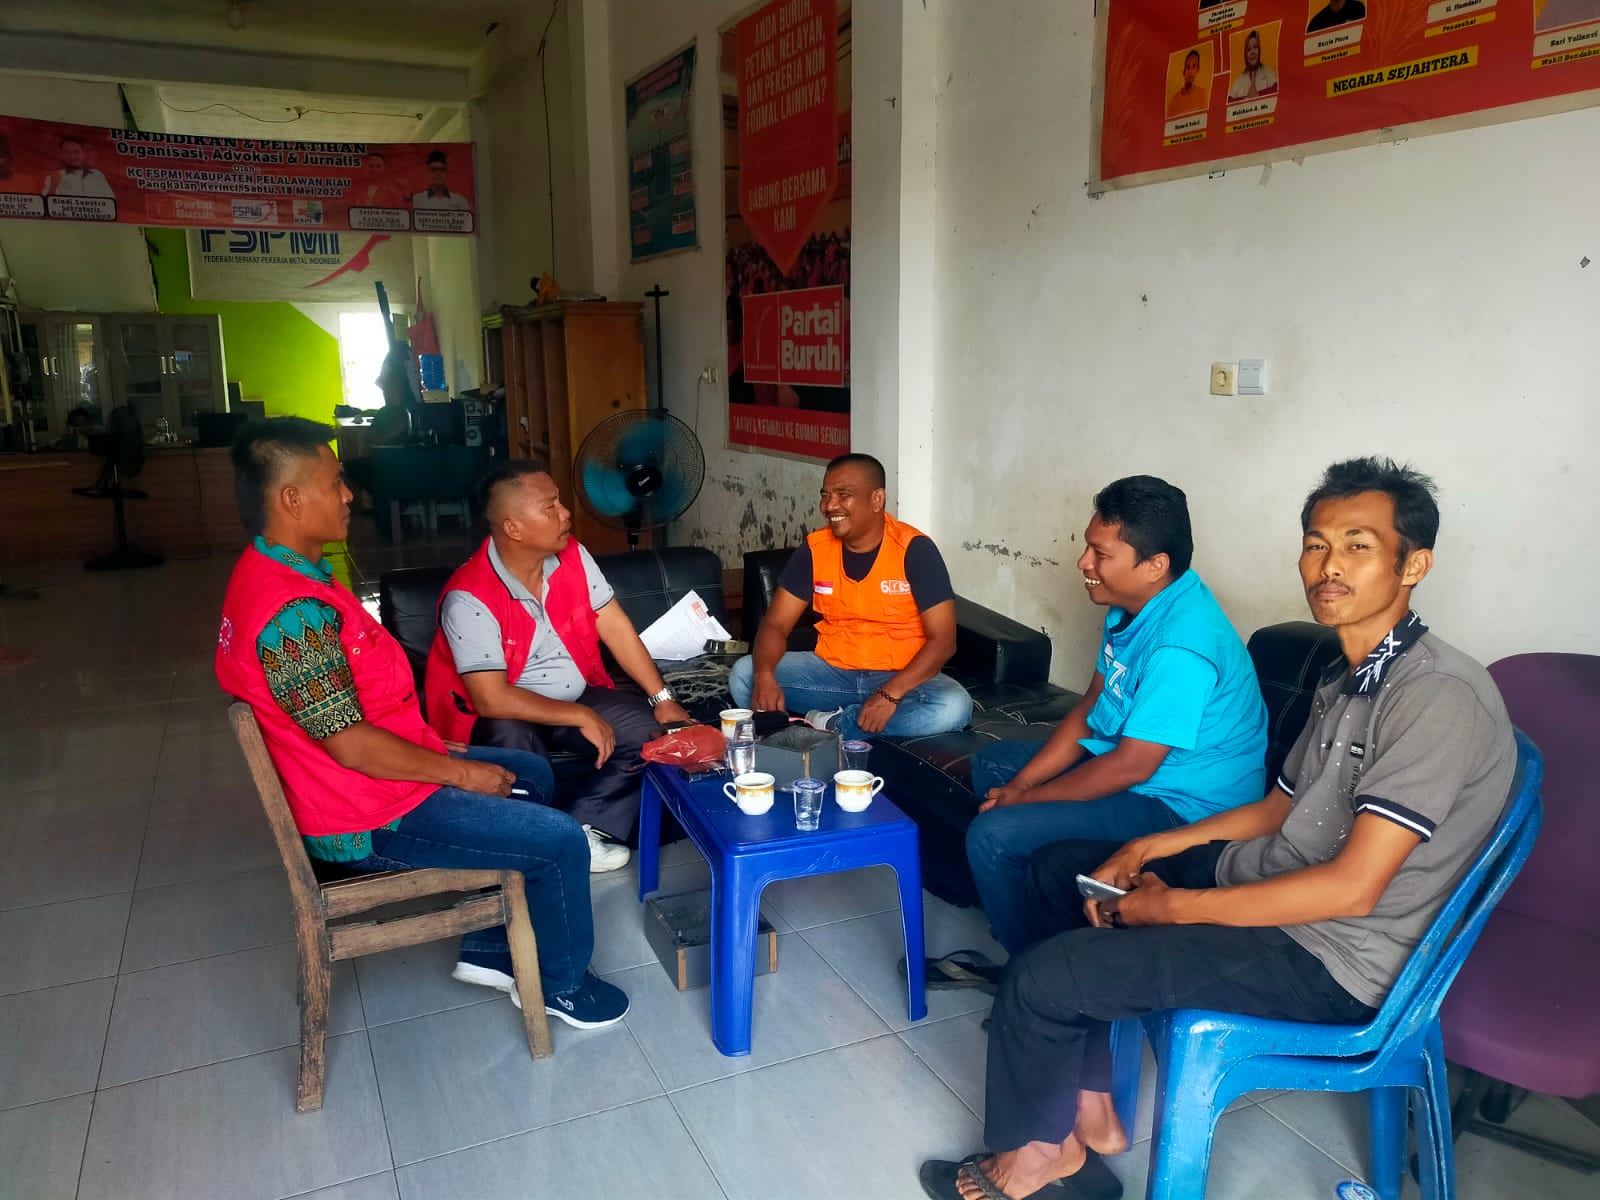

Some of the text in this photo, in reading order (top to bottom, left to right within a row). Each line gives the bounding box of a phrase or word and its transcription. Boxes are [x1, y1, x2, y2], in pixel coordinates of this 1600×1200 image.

[1333, 52, 1469, 93] NEGARA SEJAHTERA
[111, 128, 236, 147] PENDIDIKAN
[260, 140, 367, 153] PELATIHAN
[213, 149, 283, 163] Advokasi
[288, 152, 297, 164] &
[303, 152, 361, 167] Jurnalis
[127, 168, 351, 188] KC FSPMI KABUPATEN PELALAWAN RIAU
[138, 179, 197, 191] Pangkalan
[296, 186, 314, 195] Mei
[317, 187, 342, 196] 2024
[782, 166, 827, 202] BERSAMA
[773, 205, 796, 232] KAMI
[781, 301, 840, 337] Partai
[781, 337, 840, 371] Buruh
